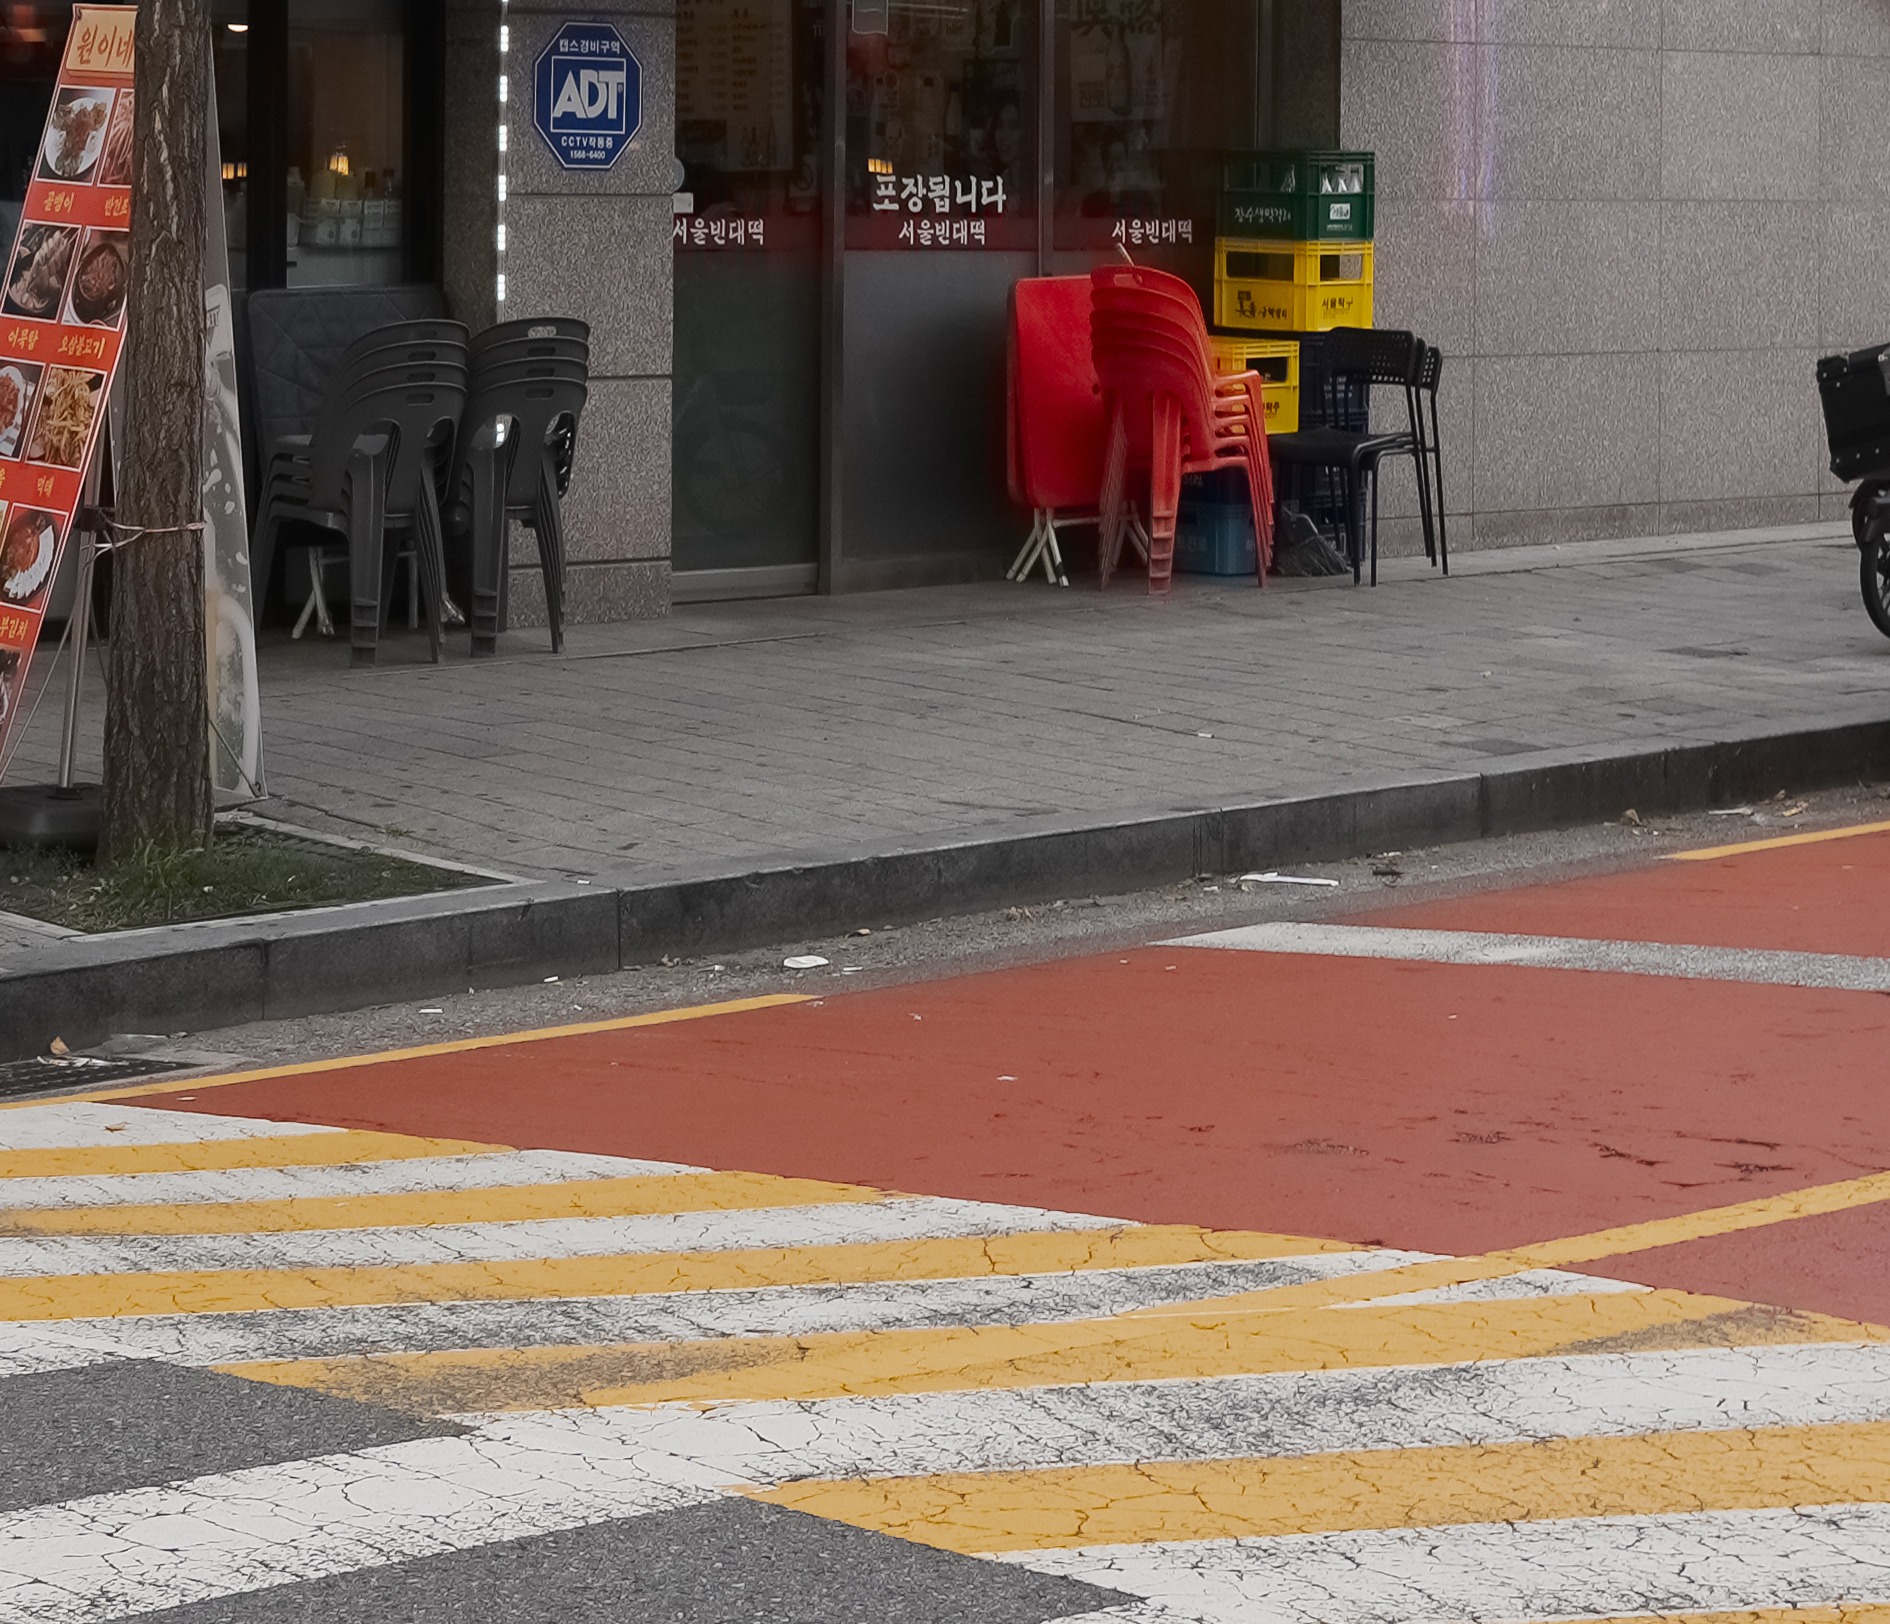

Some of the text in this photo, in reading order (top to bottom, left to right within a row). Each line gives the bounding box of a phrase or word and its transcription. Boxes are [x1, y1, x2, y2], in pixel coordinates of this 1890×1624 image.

[560, 39, 620, 54] 캡스경비구역
[553, 69, 624, 119] ADT
[873, 174, 1006, 213] 포장됩니다
[673, 218, 765, 245] 서울빈대떡
[898, 219, 986, 245] 서울빈대떡
[1112, 219, 1193, 244] 서울빈대떡
